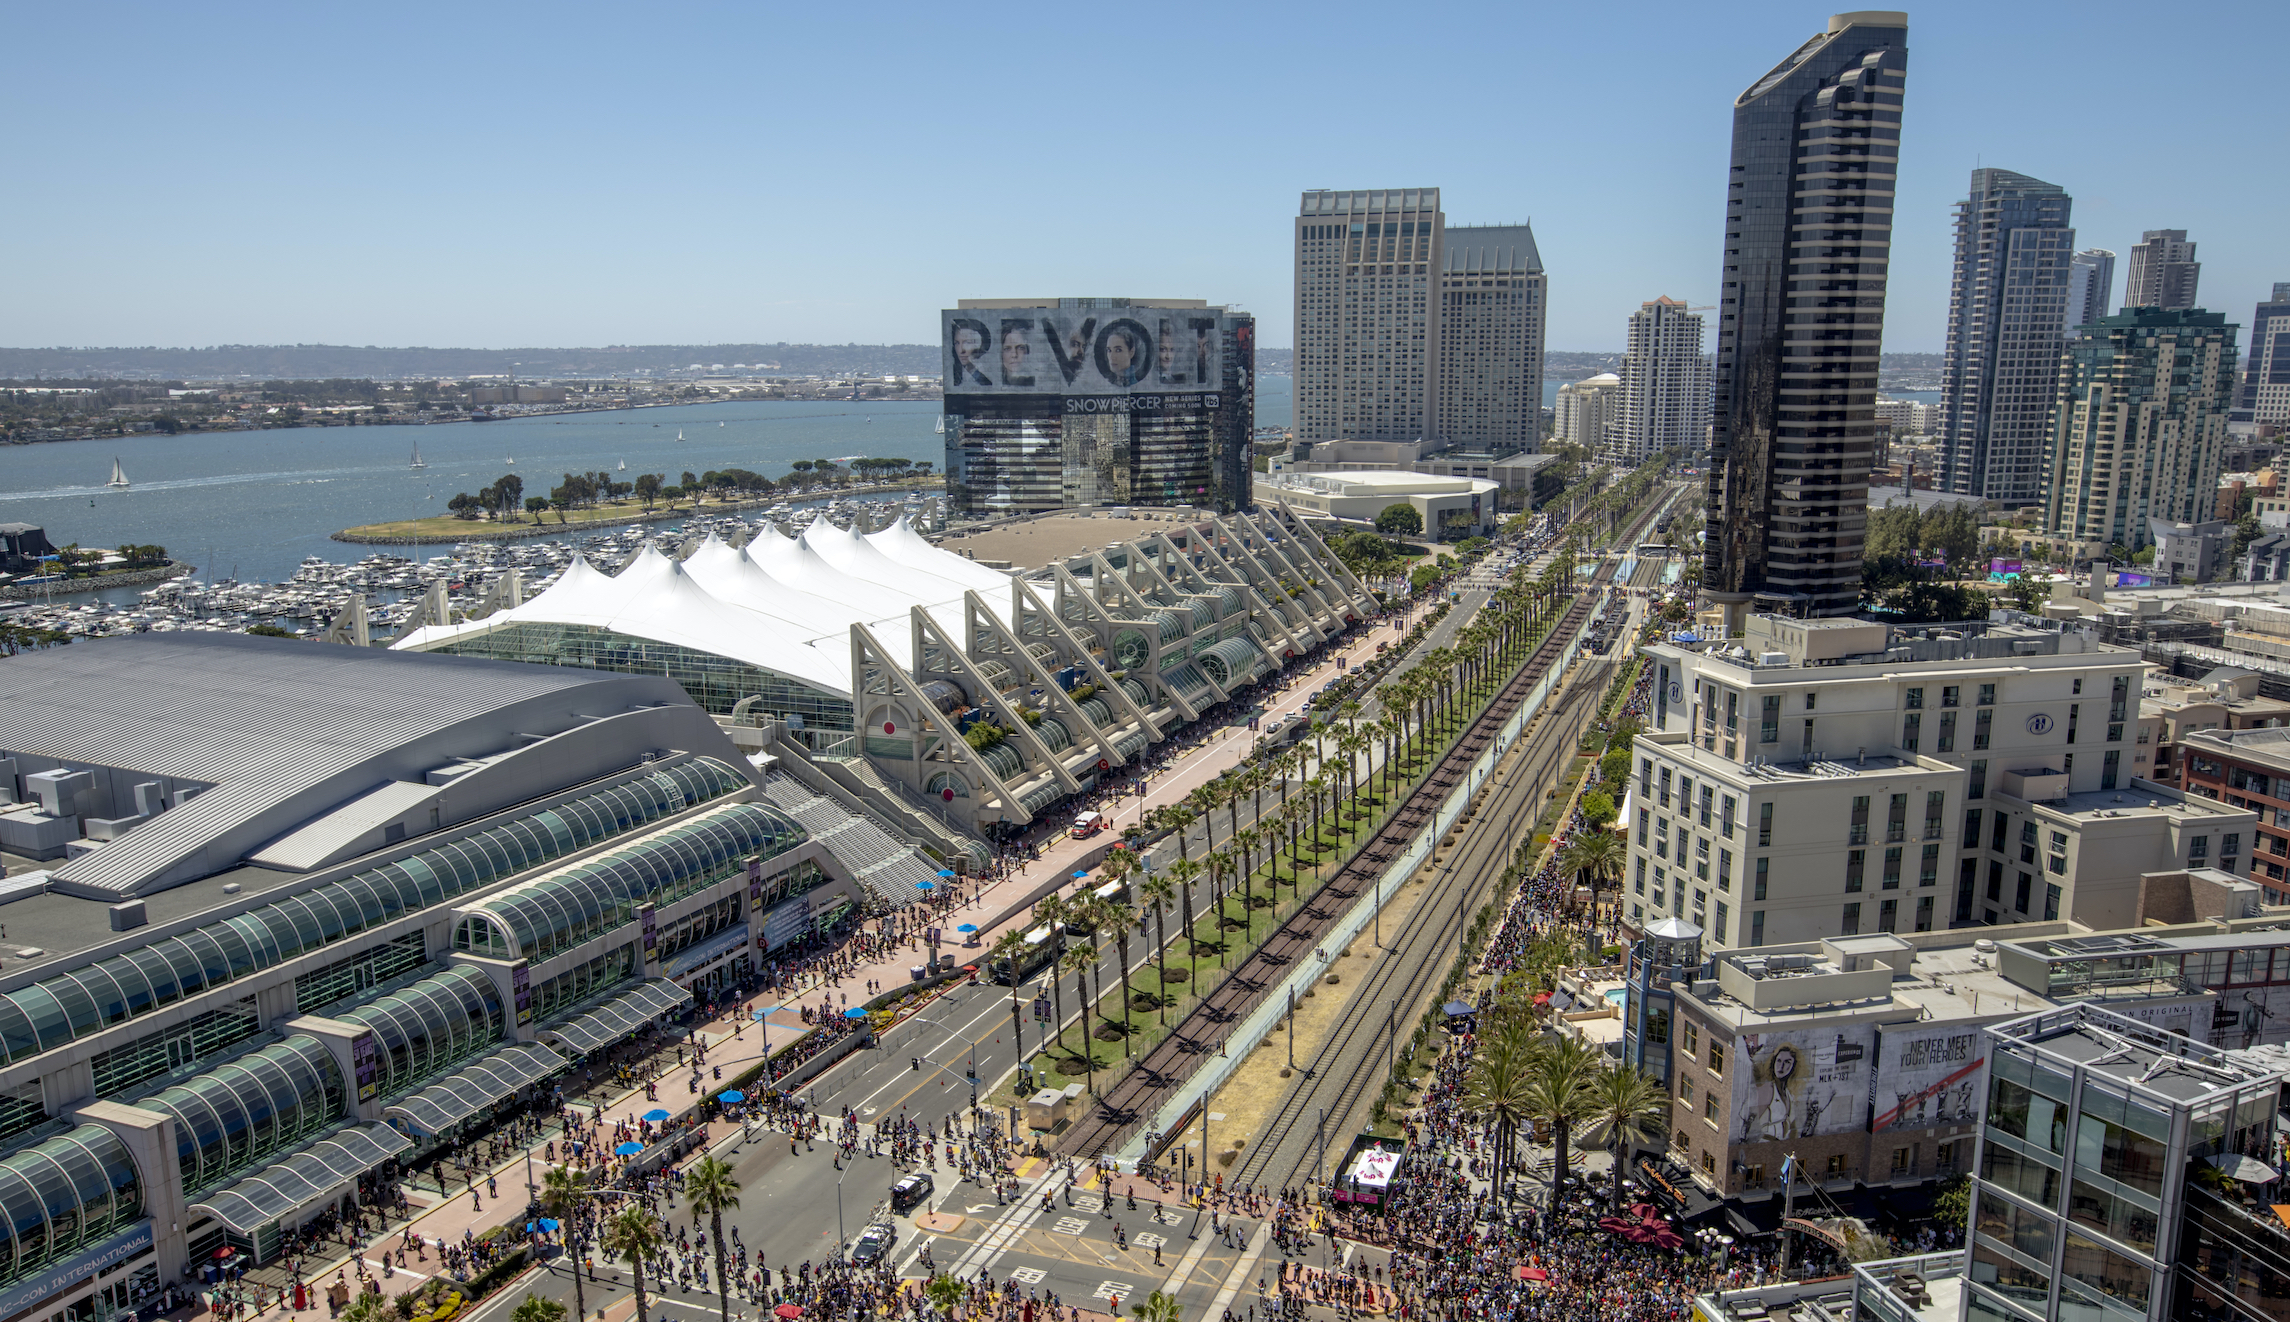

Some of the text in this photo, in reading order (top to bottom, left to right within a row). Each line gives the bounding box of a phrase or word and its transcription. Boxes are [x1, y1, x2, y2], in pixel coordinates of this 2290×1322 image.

[951, 317, 1215, 387] REVOLT
[1066, 396, 1161, 413] SNOWPIERCER
[1181, 394, 1201, 402] SERIES
[1100, 760, 1107, 768] C
[675, 932, 747, 973] COMIC-CON INTERNATIONAL
[2141, 1006, 2193, 1017] ORIGINAL
[1910, 1034, 1974, 1054] NEVER MEET
[1838, 1049, 1861, 1057] EXPERIENCE
[1900, 1046, 1966, 1067] YOUR HEROES
[1819, 1074, 1832, 1083] MLK
[1796, 1206, 1835, 1218] Mickey's
[51, 1235, 149, 1290] INTERNATIONAL
